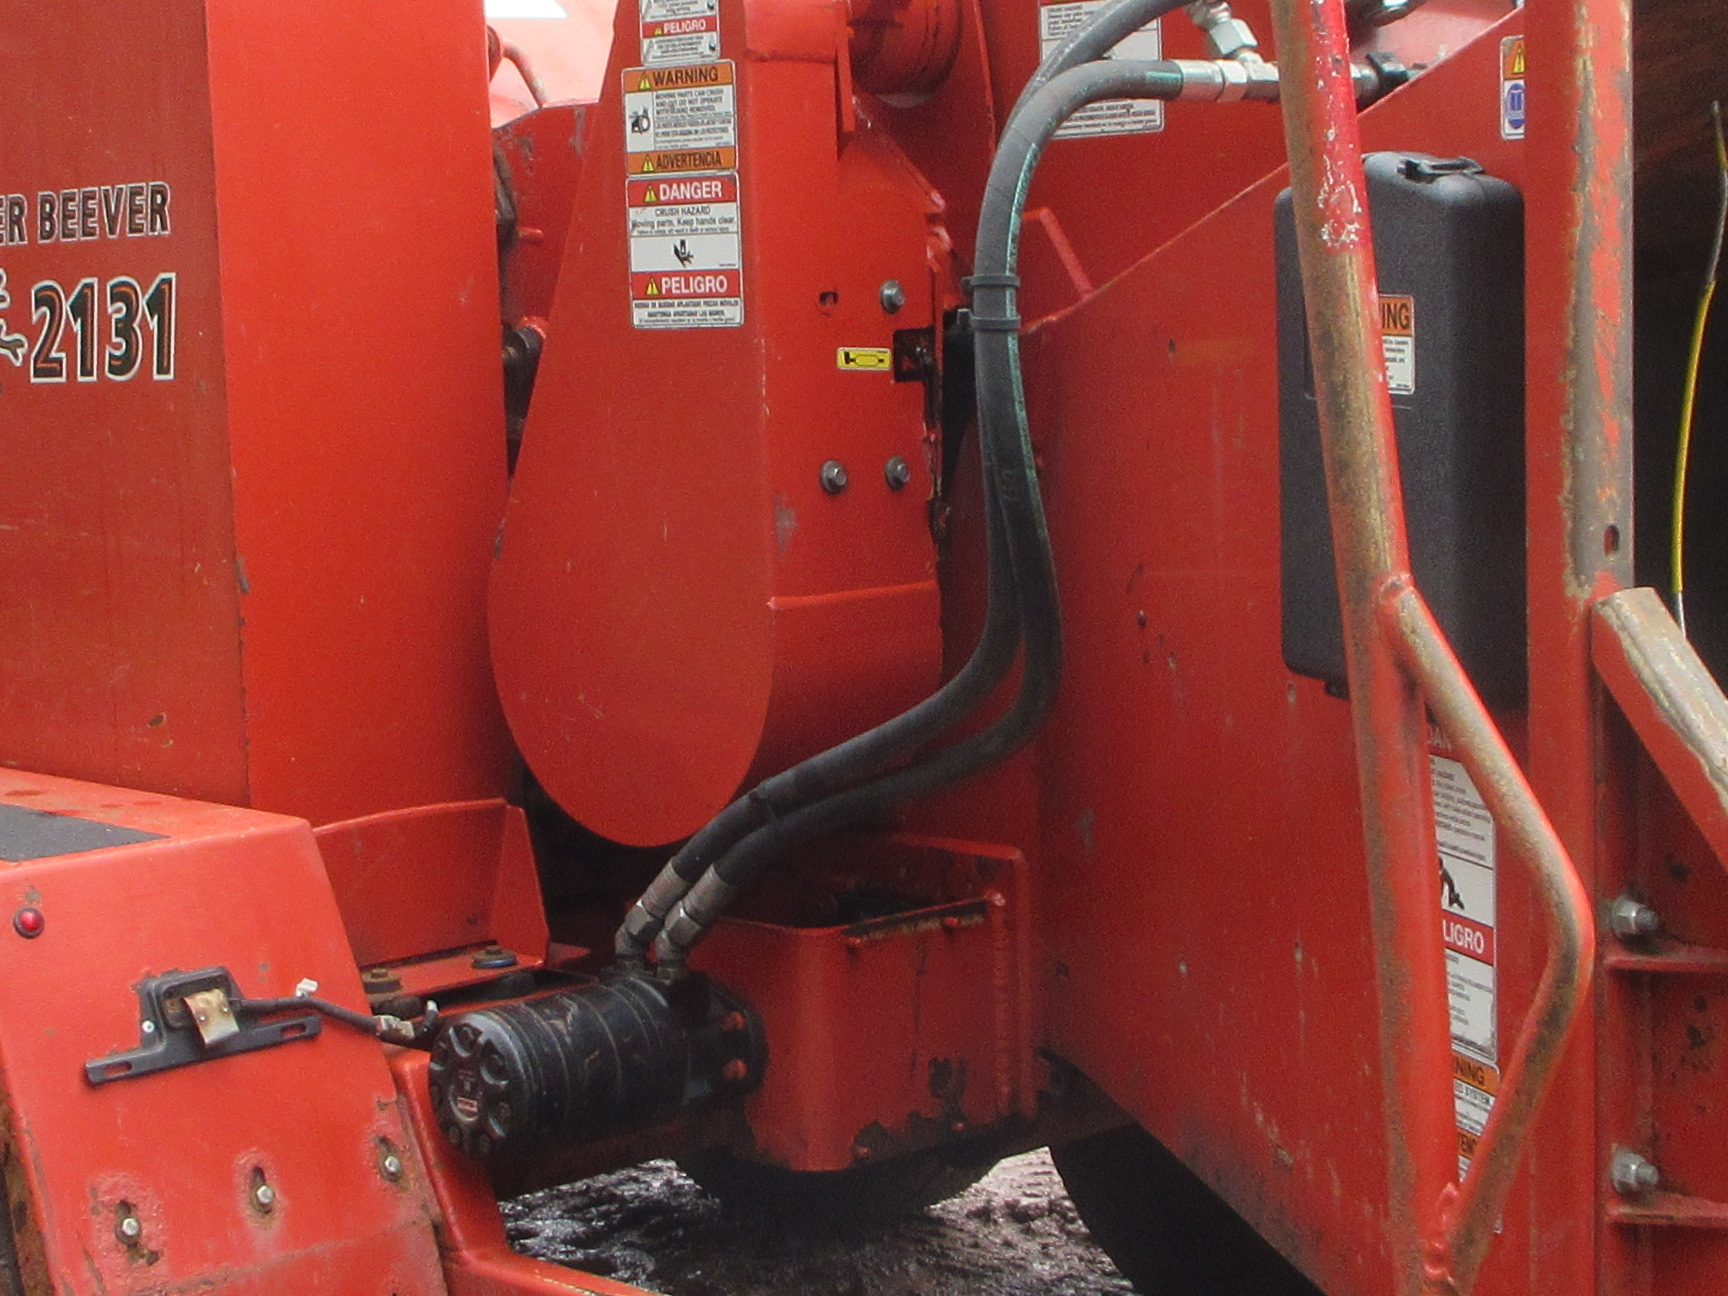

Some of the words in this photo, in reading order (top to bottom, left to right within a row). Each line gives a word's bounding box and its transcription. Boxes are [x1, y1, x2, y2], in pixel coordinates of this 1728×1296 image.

[663, 18, 707, 35] PELIGRO
[653, 65, 719, 87] WARNING
[656, 150, 722, 170] ADVERTENCIA
[659, 180, 723, 201] DANGER
[37, 181, 172, 244] BEEVER
[681, 205, 711, 216] HAZARD
[661, 275, 728, 295] PELIGRO
[30, 271, 177, 384] 2131
[1442, 919, 1485, 955] LIGRO
[1455, 1056, 1485, 1085] NING
